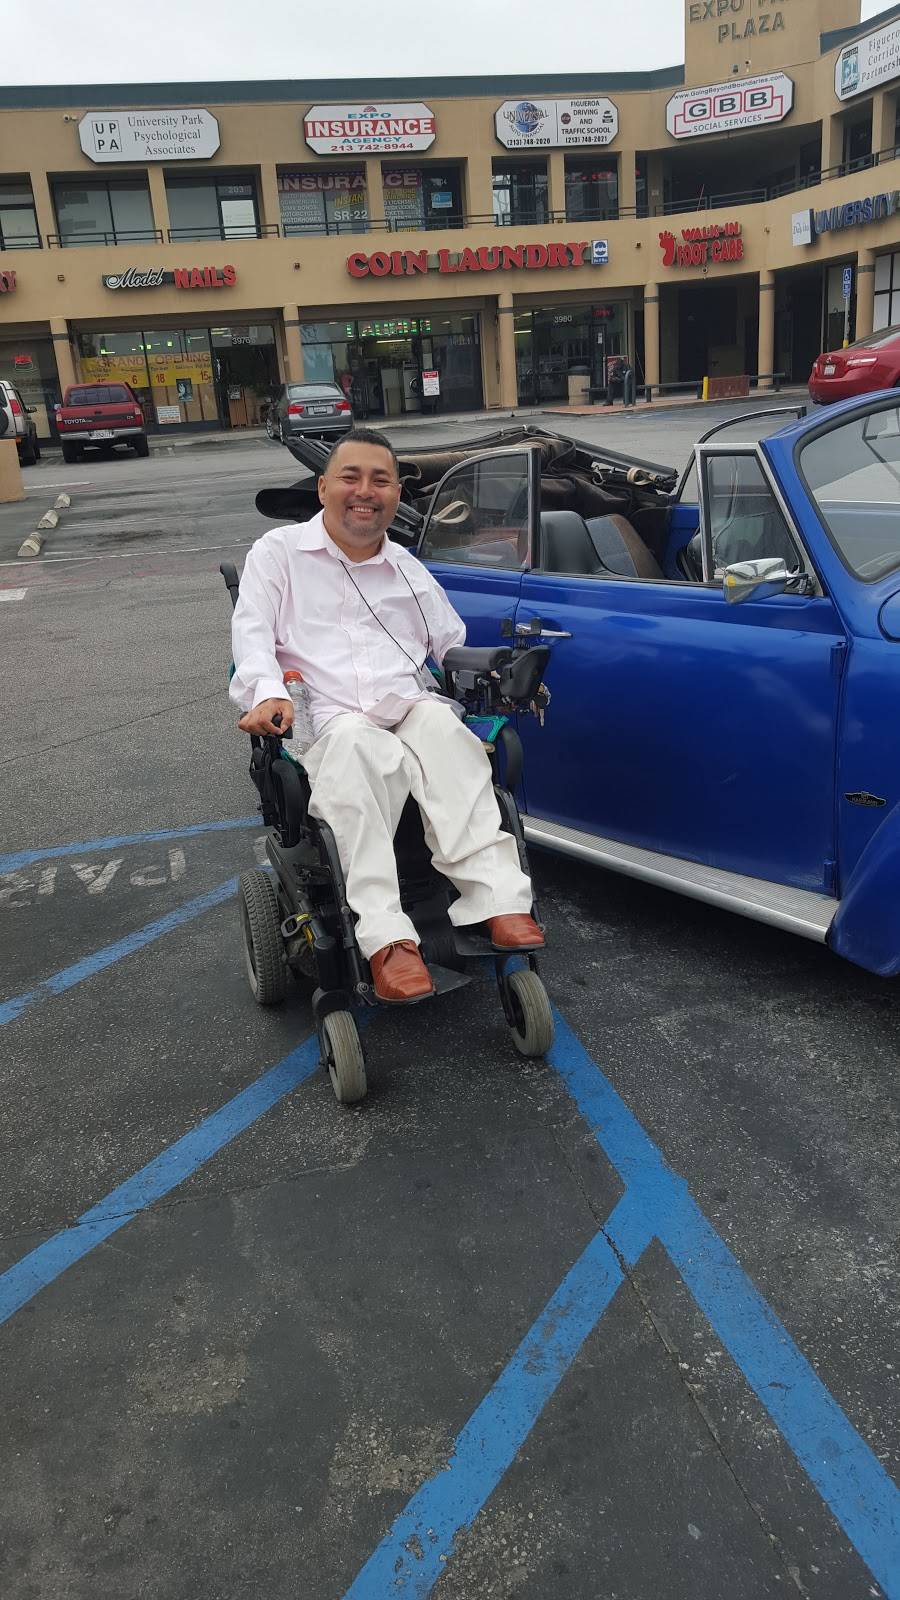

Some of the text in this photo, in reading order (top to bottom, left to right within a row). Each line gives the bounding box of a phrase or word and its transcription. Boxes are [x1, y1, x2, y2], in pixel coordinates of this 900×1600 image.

[718, 12, 785, 43] PLAZA
[674, 74, 785, 100] www.GoingBeyondBoundaries.com
[127, 114, 204, 128] University Park
[307, 119, 432, 137] INSURANCE
[693, 114, 762, 133] SOCIAL SERVICES
[134, 129, 201, 143] Psychological
[145, 144, 196, 155] Associates
[334, 210, 368, 221] SR-22
[815, 191, 894, 234] UNIVERSITY
[681, 221, 740, 242] WALK-IN
[347, 242, 588, 278] COIN LAUNDRY
[677, 239, 743, 268] FOOT CARE
[106, 265, 237, 289] Model NAILS
[96, 352, 209, 368] GRAND OPENING
[132, 375, 138, 384] 6
[156, 373, 166, 383] 18
